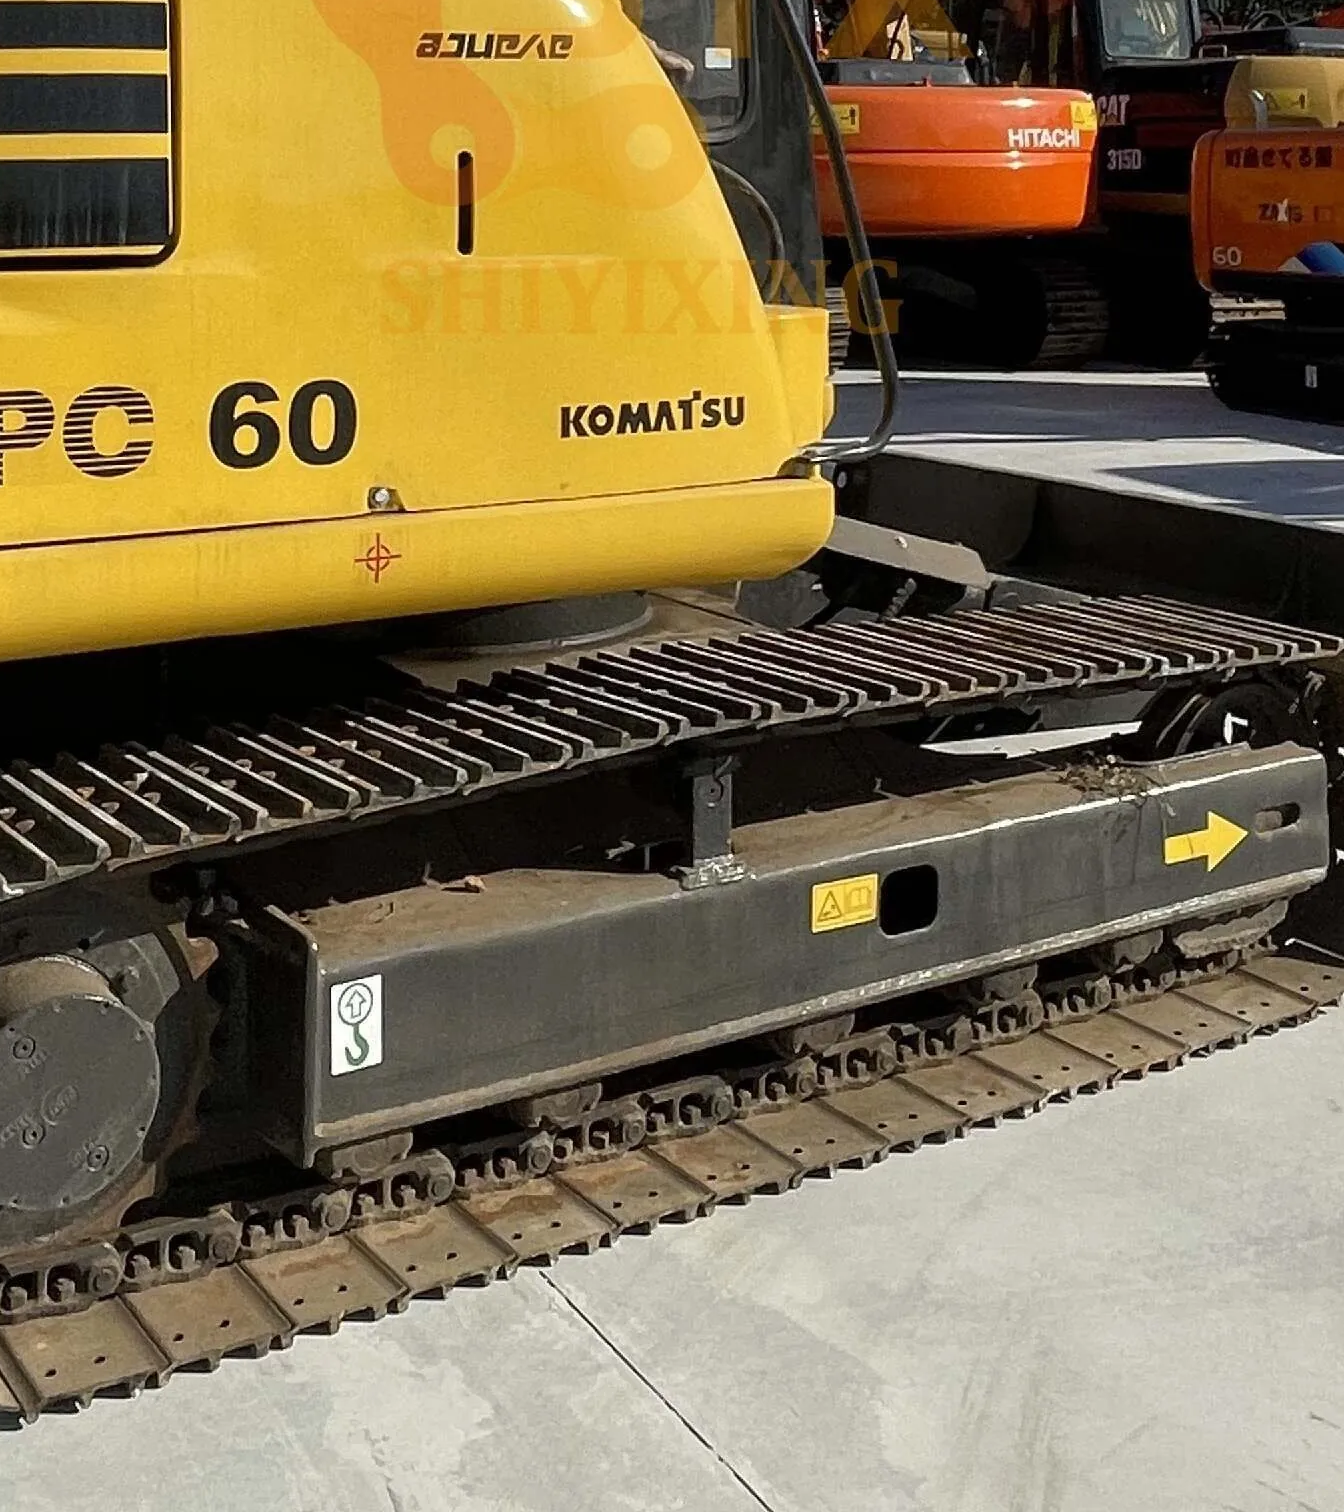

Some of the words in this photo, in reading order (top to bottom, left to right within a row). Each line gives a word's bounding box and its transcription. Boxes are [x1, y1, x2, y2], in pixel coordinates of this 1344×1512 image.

[1096, 94, 1131, 127] CAT
[1008, 128, 1080, 148] HITACHI
[1107, 149, 1142, 171] 315D
[1211, 246, 1242, 267] 60
[208, 378, 359, 471] 60
[559, 389, 746, 440] KOMATSU
